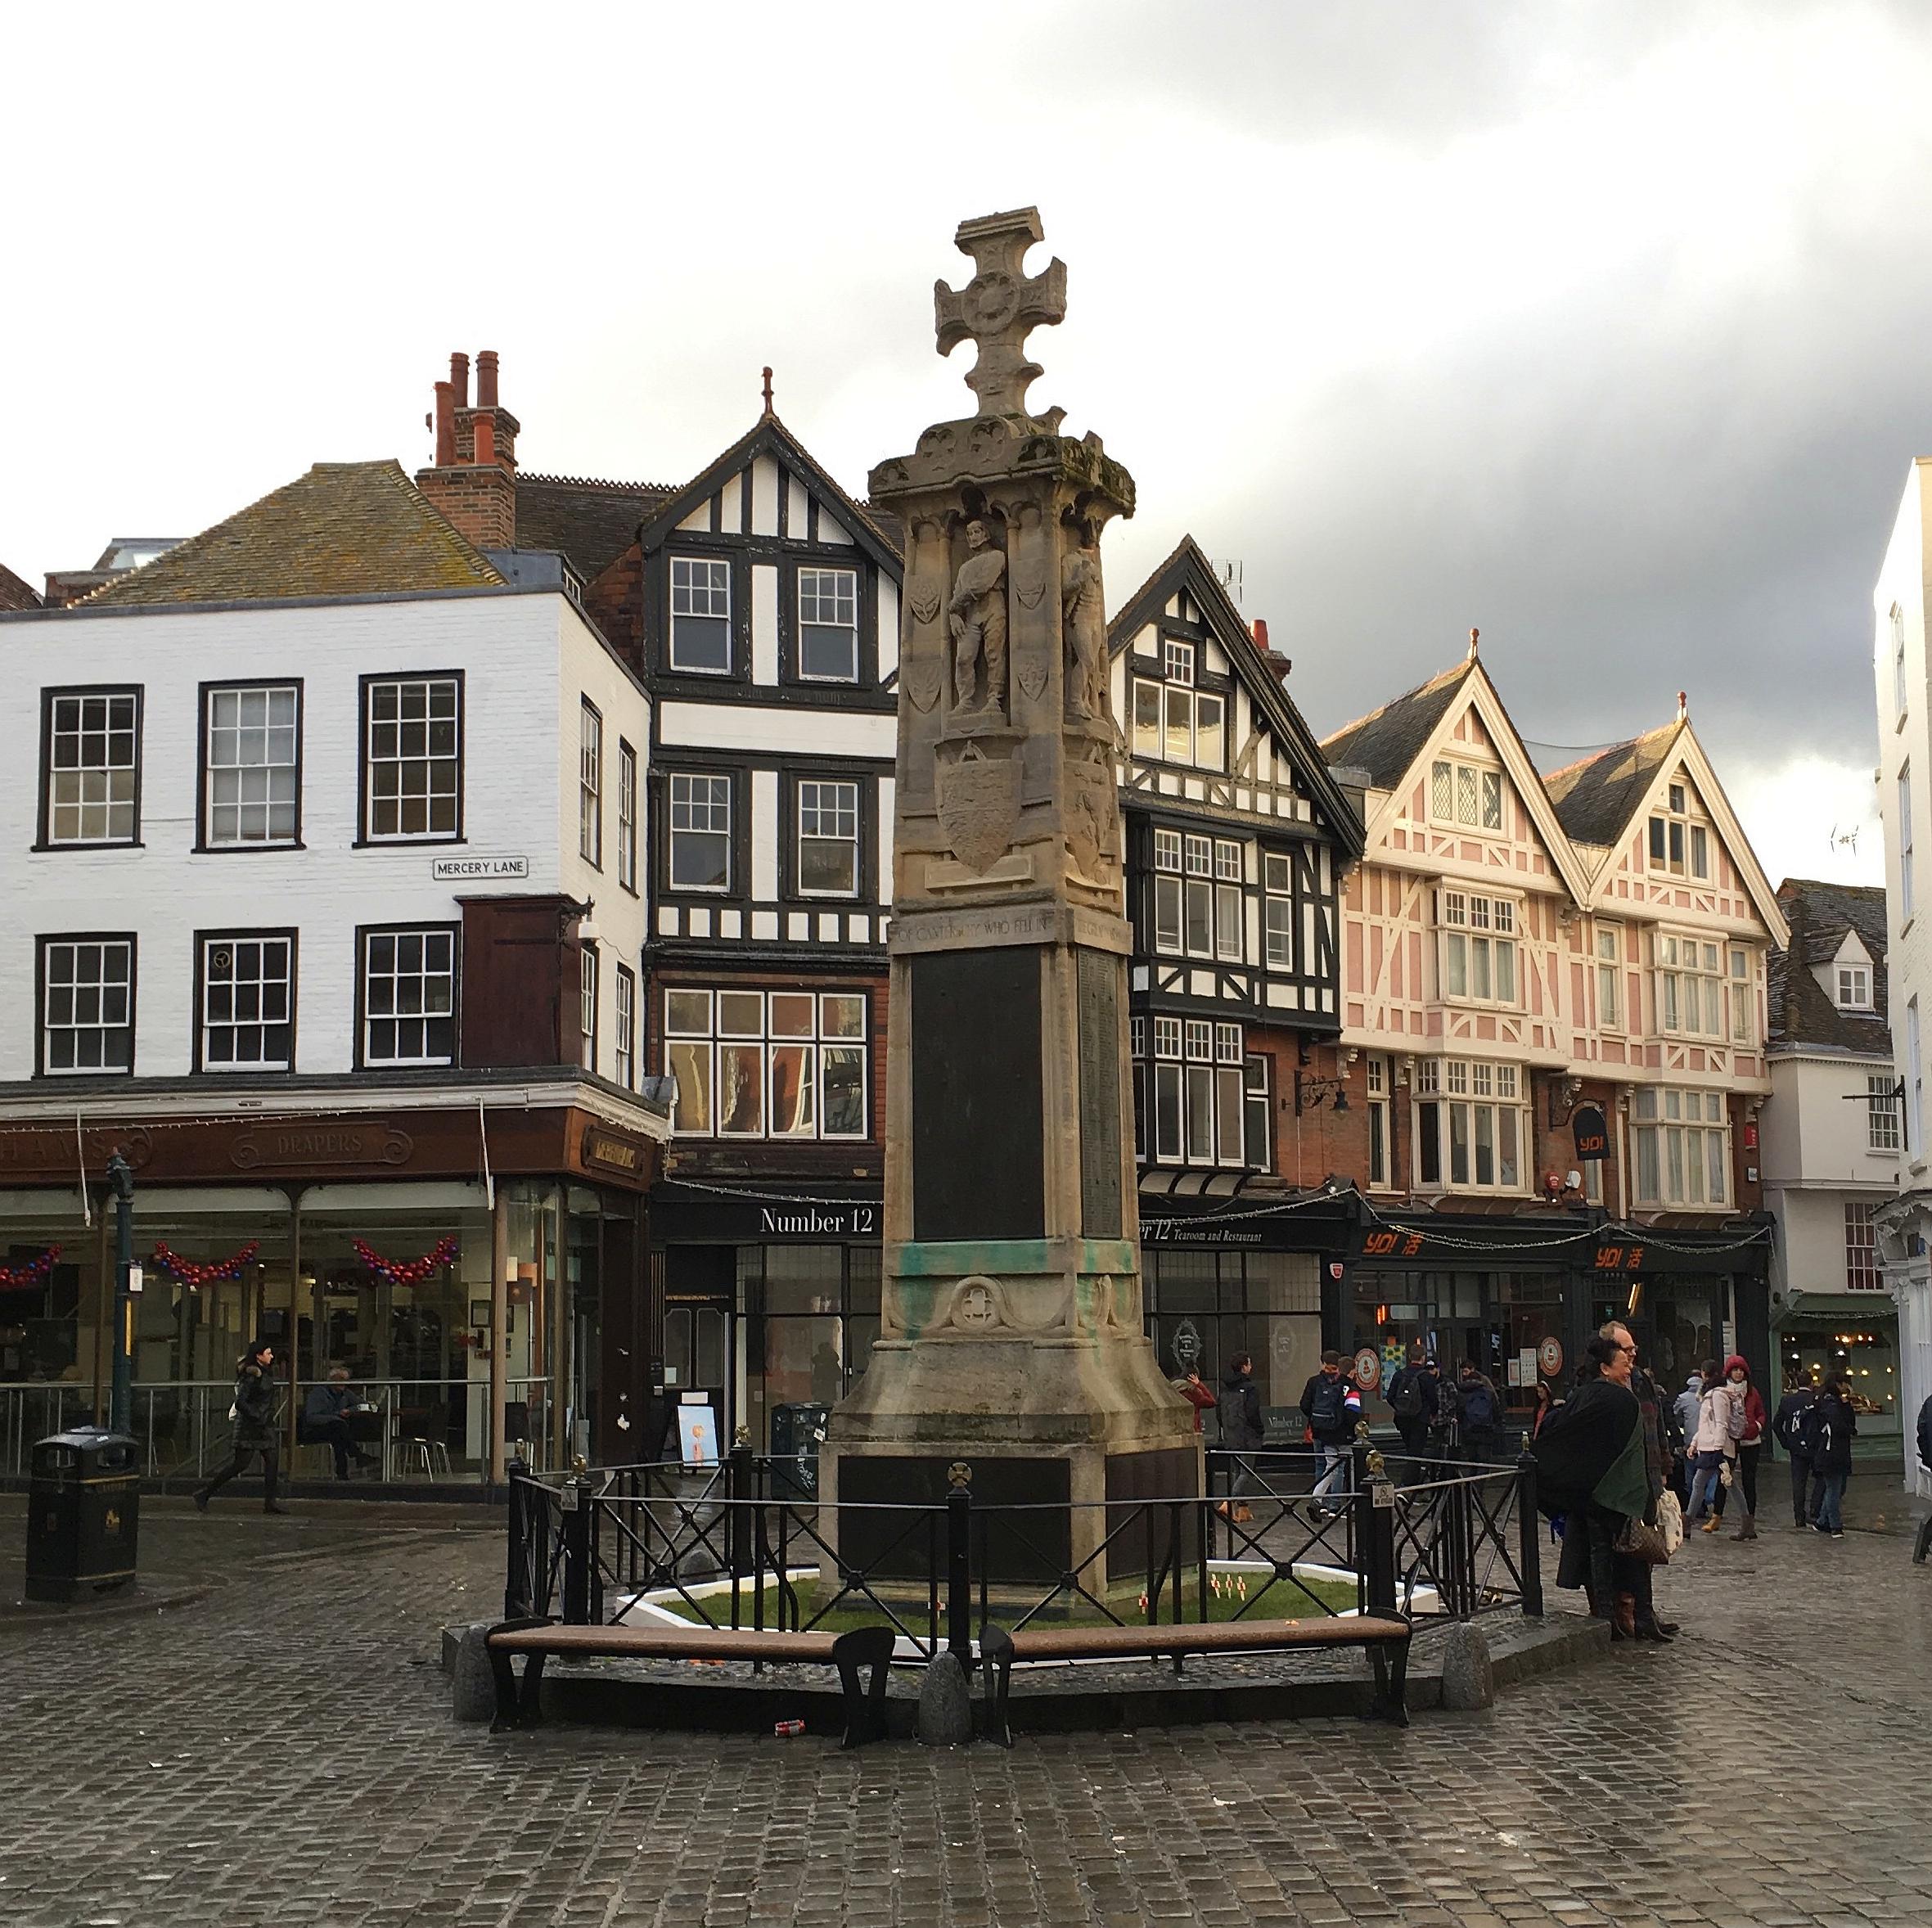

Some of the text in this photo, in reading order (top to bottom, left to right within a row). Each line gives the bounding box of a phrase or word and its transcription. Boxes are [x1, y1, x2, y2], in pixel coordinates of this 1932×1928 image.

[438, 861, 524, 875] MERCERY LANE
[984, 920, 1011, 937] WHO
[1036, 917, 1047, 931] IN
[759, 1208, 873, 1233] Number 12
[1155, 1219, 1172, 1240] 12
[1173, 1228, 1205, 1241] Tearoom
[1207, 1229, 1223, 1241] and
[1223, 1230, 1262, 1242] Restaurant
